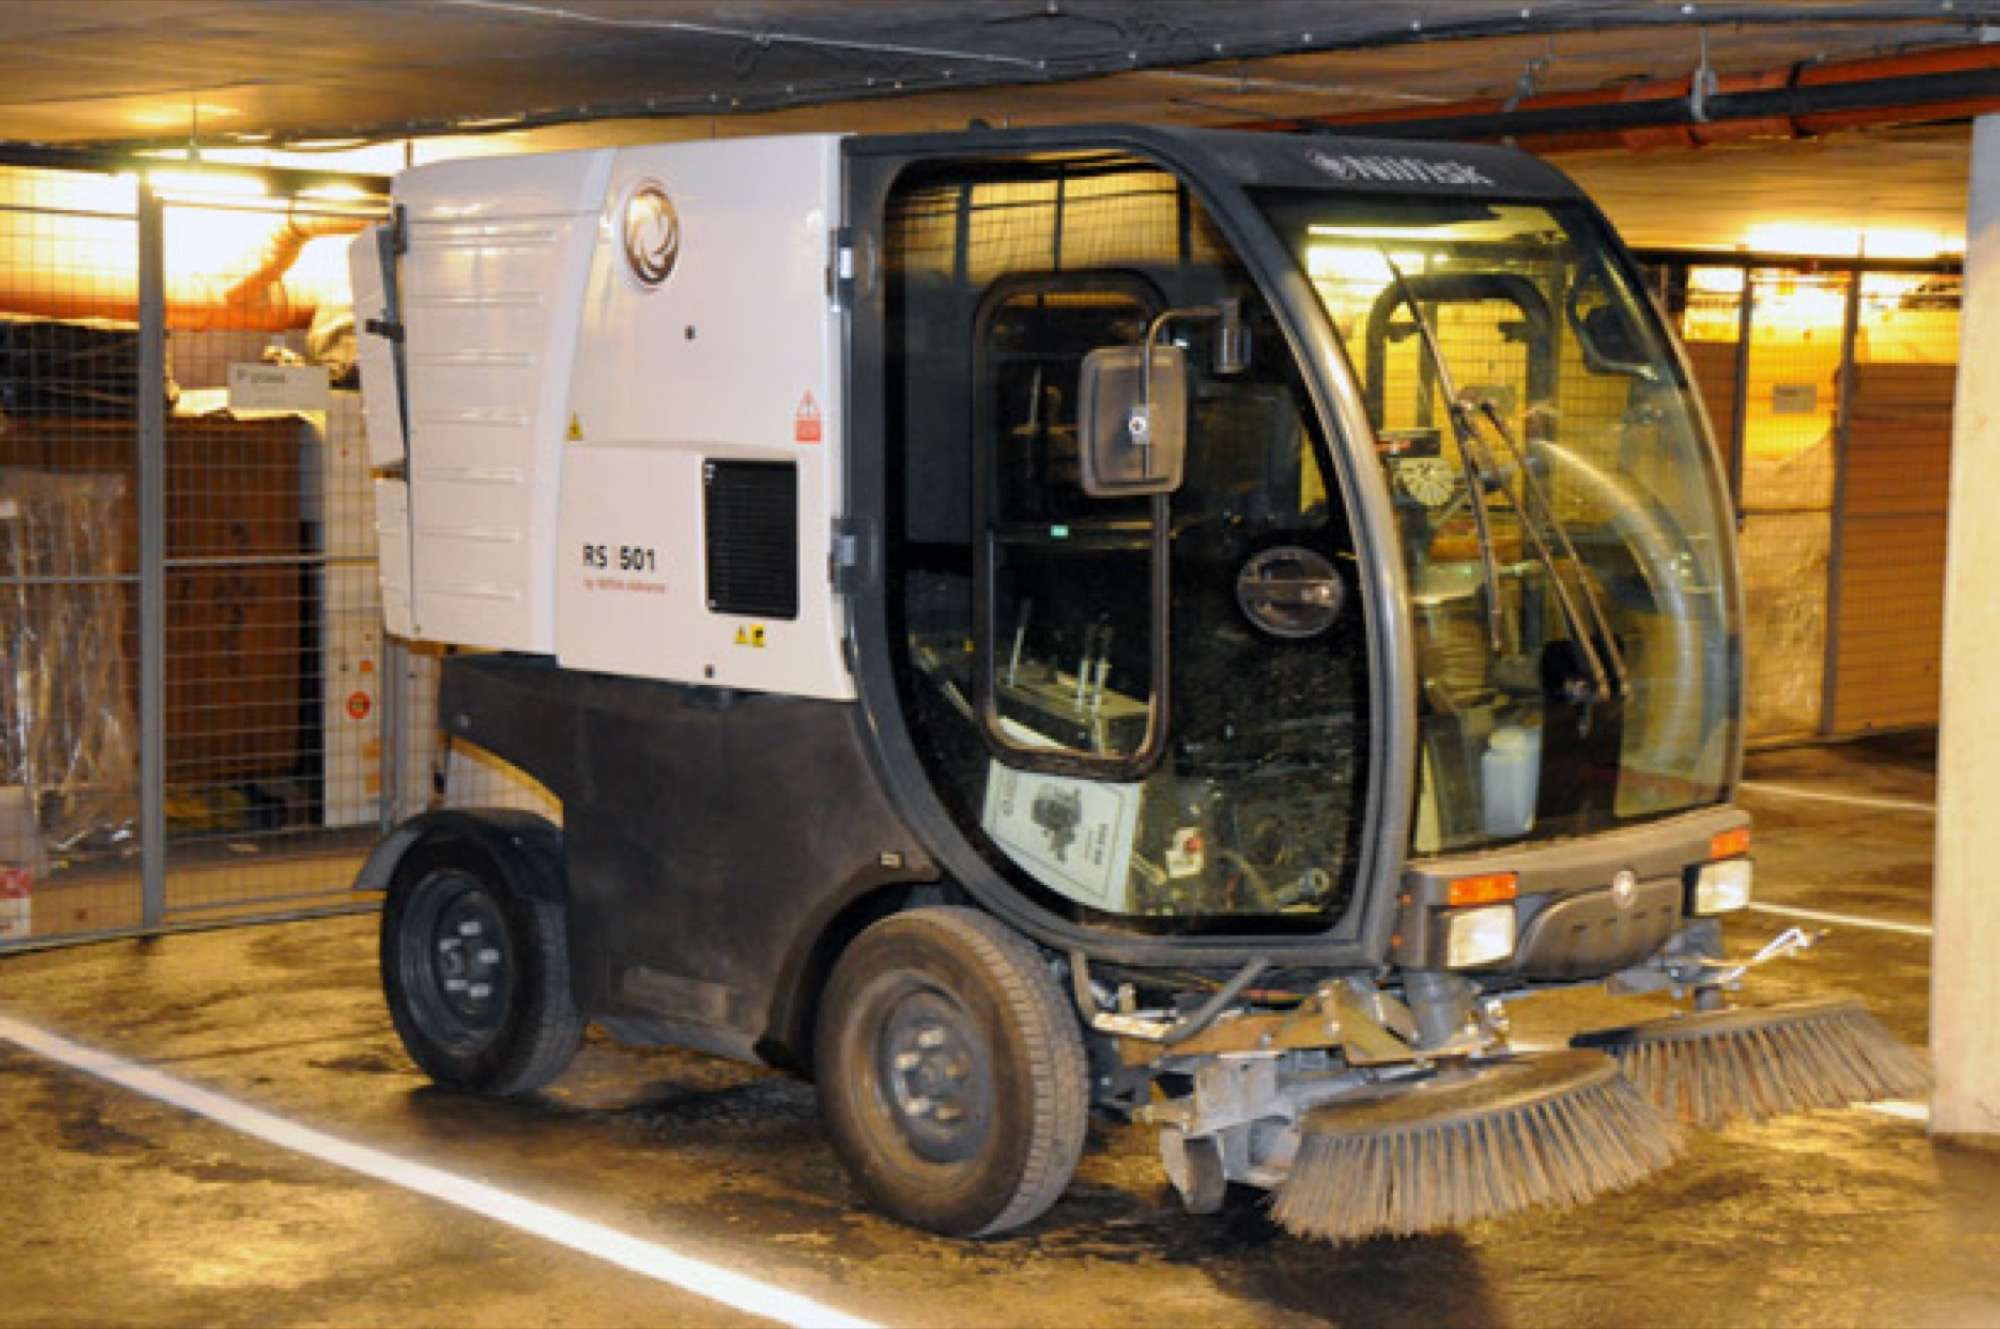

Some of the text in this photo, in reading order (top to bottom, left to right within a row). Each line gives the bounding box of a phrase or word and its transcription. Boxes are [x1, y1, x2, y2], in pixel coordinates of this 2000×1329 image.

[1341, 154, 1495, 185] Nilfisk
[582, 545, 655, 571] RS 501
